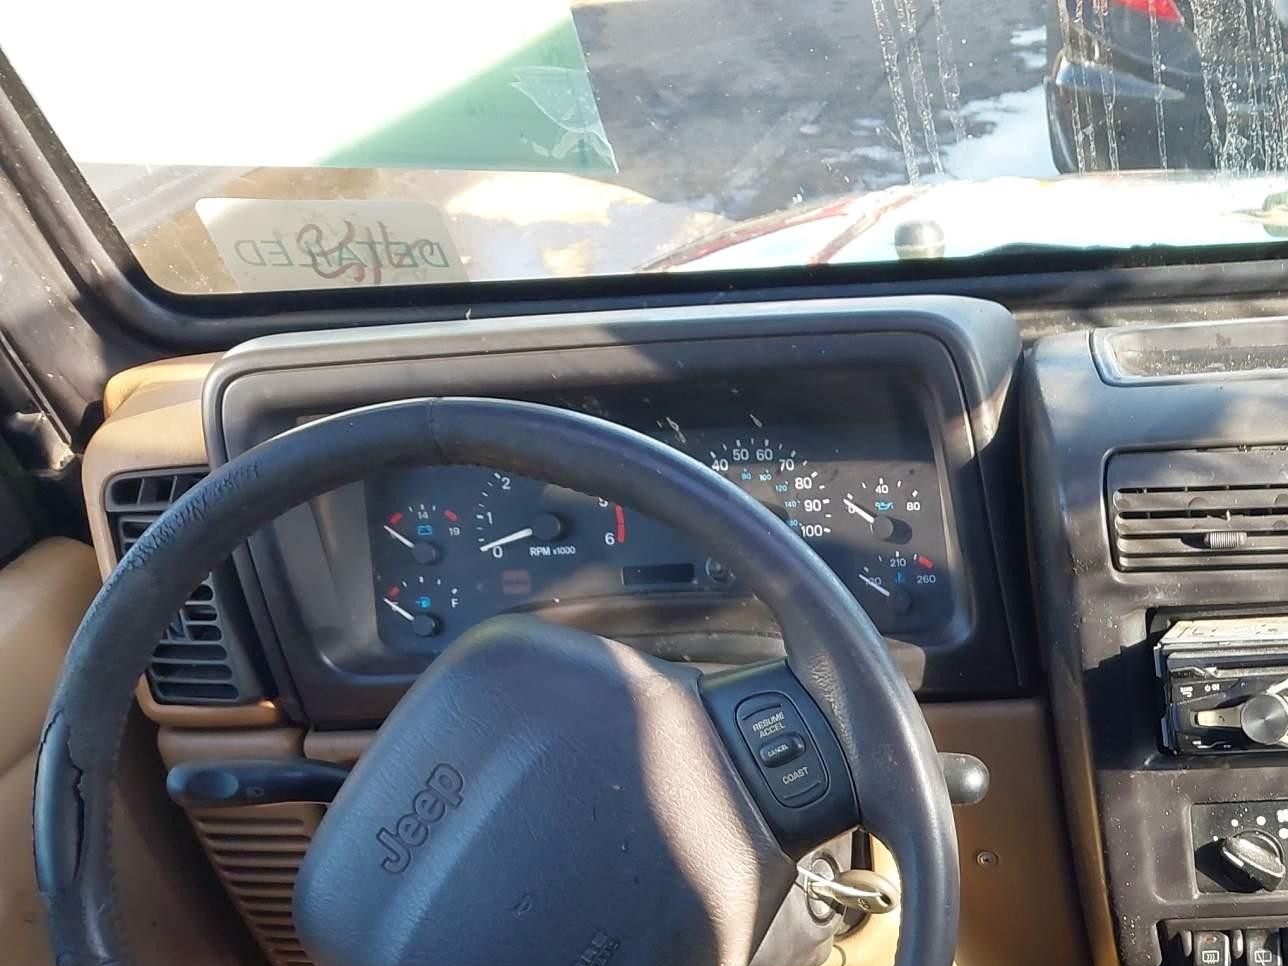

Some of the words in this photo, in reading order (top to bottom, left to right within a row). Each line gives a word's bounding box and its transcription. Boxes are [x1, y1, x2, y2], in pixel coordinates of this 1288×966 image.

[733, 448, 749, 460] 50
[756, 448, 773, 460] 60
[712, 458, 729, 472] 40
[779, 459, 795, 471] 70
[501, 477, 511, 489] 2
[794, 477, 812, 489] 80
[875, 484, 889, 494] 40
[784, 500, 797, 508] 140
[804, 499, 821, 512] 90
[906, 501, 920, 511] 80
[418, 511, 429, 519] 14
[486, 511, 493, 524] 1
[449, 527, 460, 536] 19
[801, 525, 823, 537] 100
[605, 532, 615, 545] 6
[493, 545, 503, 558] 0
[529, 546, 551, 557] RPM
[889, 558, 906, 567] 210
[916, 574, 936, 584] 260
[451, 598, 459, 608] F
[752, 711, 785, 732] RESUME
[759, 723, 786, 738] ACCEL
[782, 767, 809, 785] COAST
[376, 763, 464, 874] Jeep
